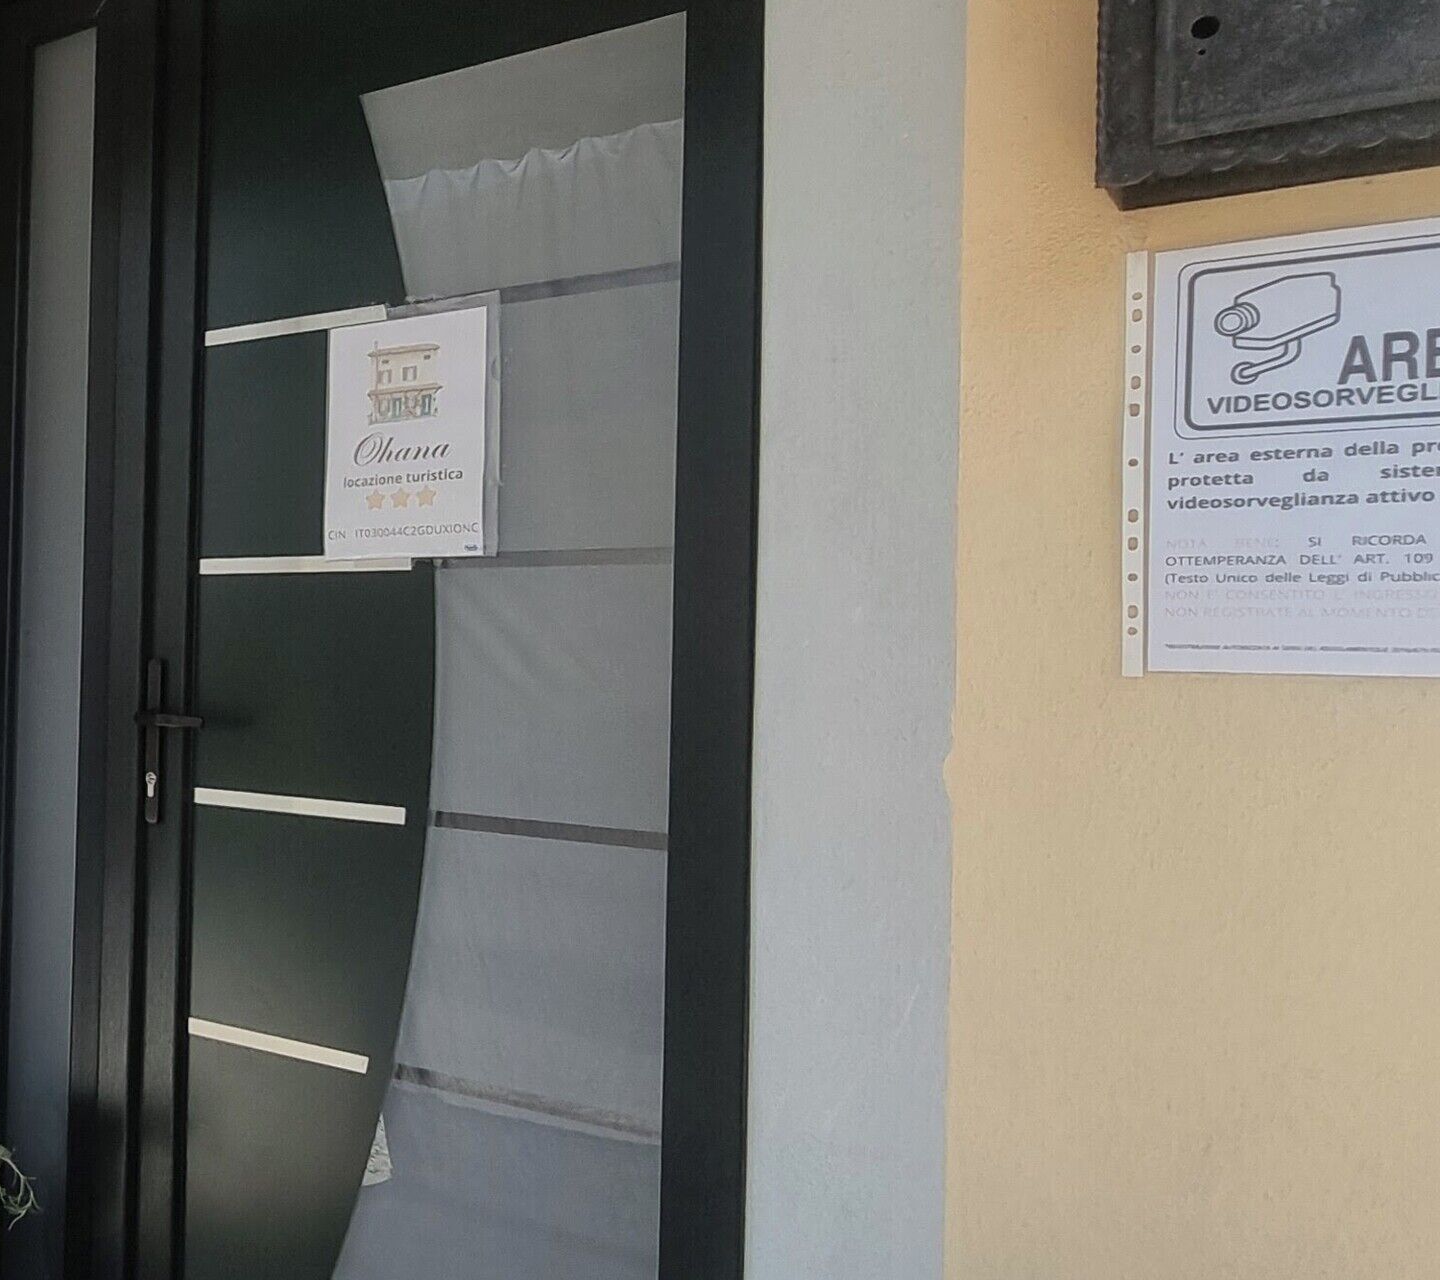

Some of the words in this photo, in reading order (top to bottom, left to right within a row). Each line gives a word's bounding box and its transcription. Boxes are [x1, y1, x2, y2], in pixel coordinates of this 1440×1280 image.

[1207, 383, 1440, 414] VIDEOSORVEGL
[353, 431, 450, 467] Ohana
[1193, 452, 1239, 463] area
[1250, 447, 1333, 461] esterna
[1344, 441, 1399, 457] della
[1411, 441, 1440, 457] pr
[343, 475, 402, 488] locazione
[406, 469, 463, 483] turistica
[1168, 473, 1254, 491] protetta
[1302, 468, 1329, 482] da
[1167, 492, 1359, 511] videosorveglianza
[1366, 488, 1435, 503] attivo
[1308, 536, 1321, 547] SI
[1352, 534, 1427, 546] RICORDA
[1165, 555, 1287, 567] OTTEMPERANZA
[1300, 553, 1342, 565] DELL'
[1353, 553, 1390, 564] ART.
[1405, 553, 1433, 564] 109
[1165, 573, 1209, 585] (Testo
[1216, 573, 1258, 583] Unico
[1265, 571, 1302, 583] delle
[1309, 572, 1349, 586] Leggi
[1357, 571, 1372, 582] di
